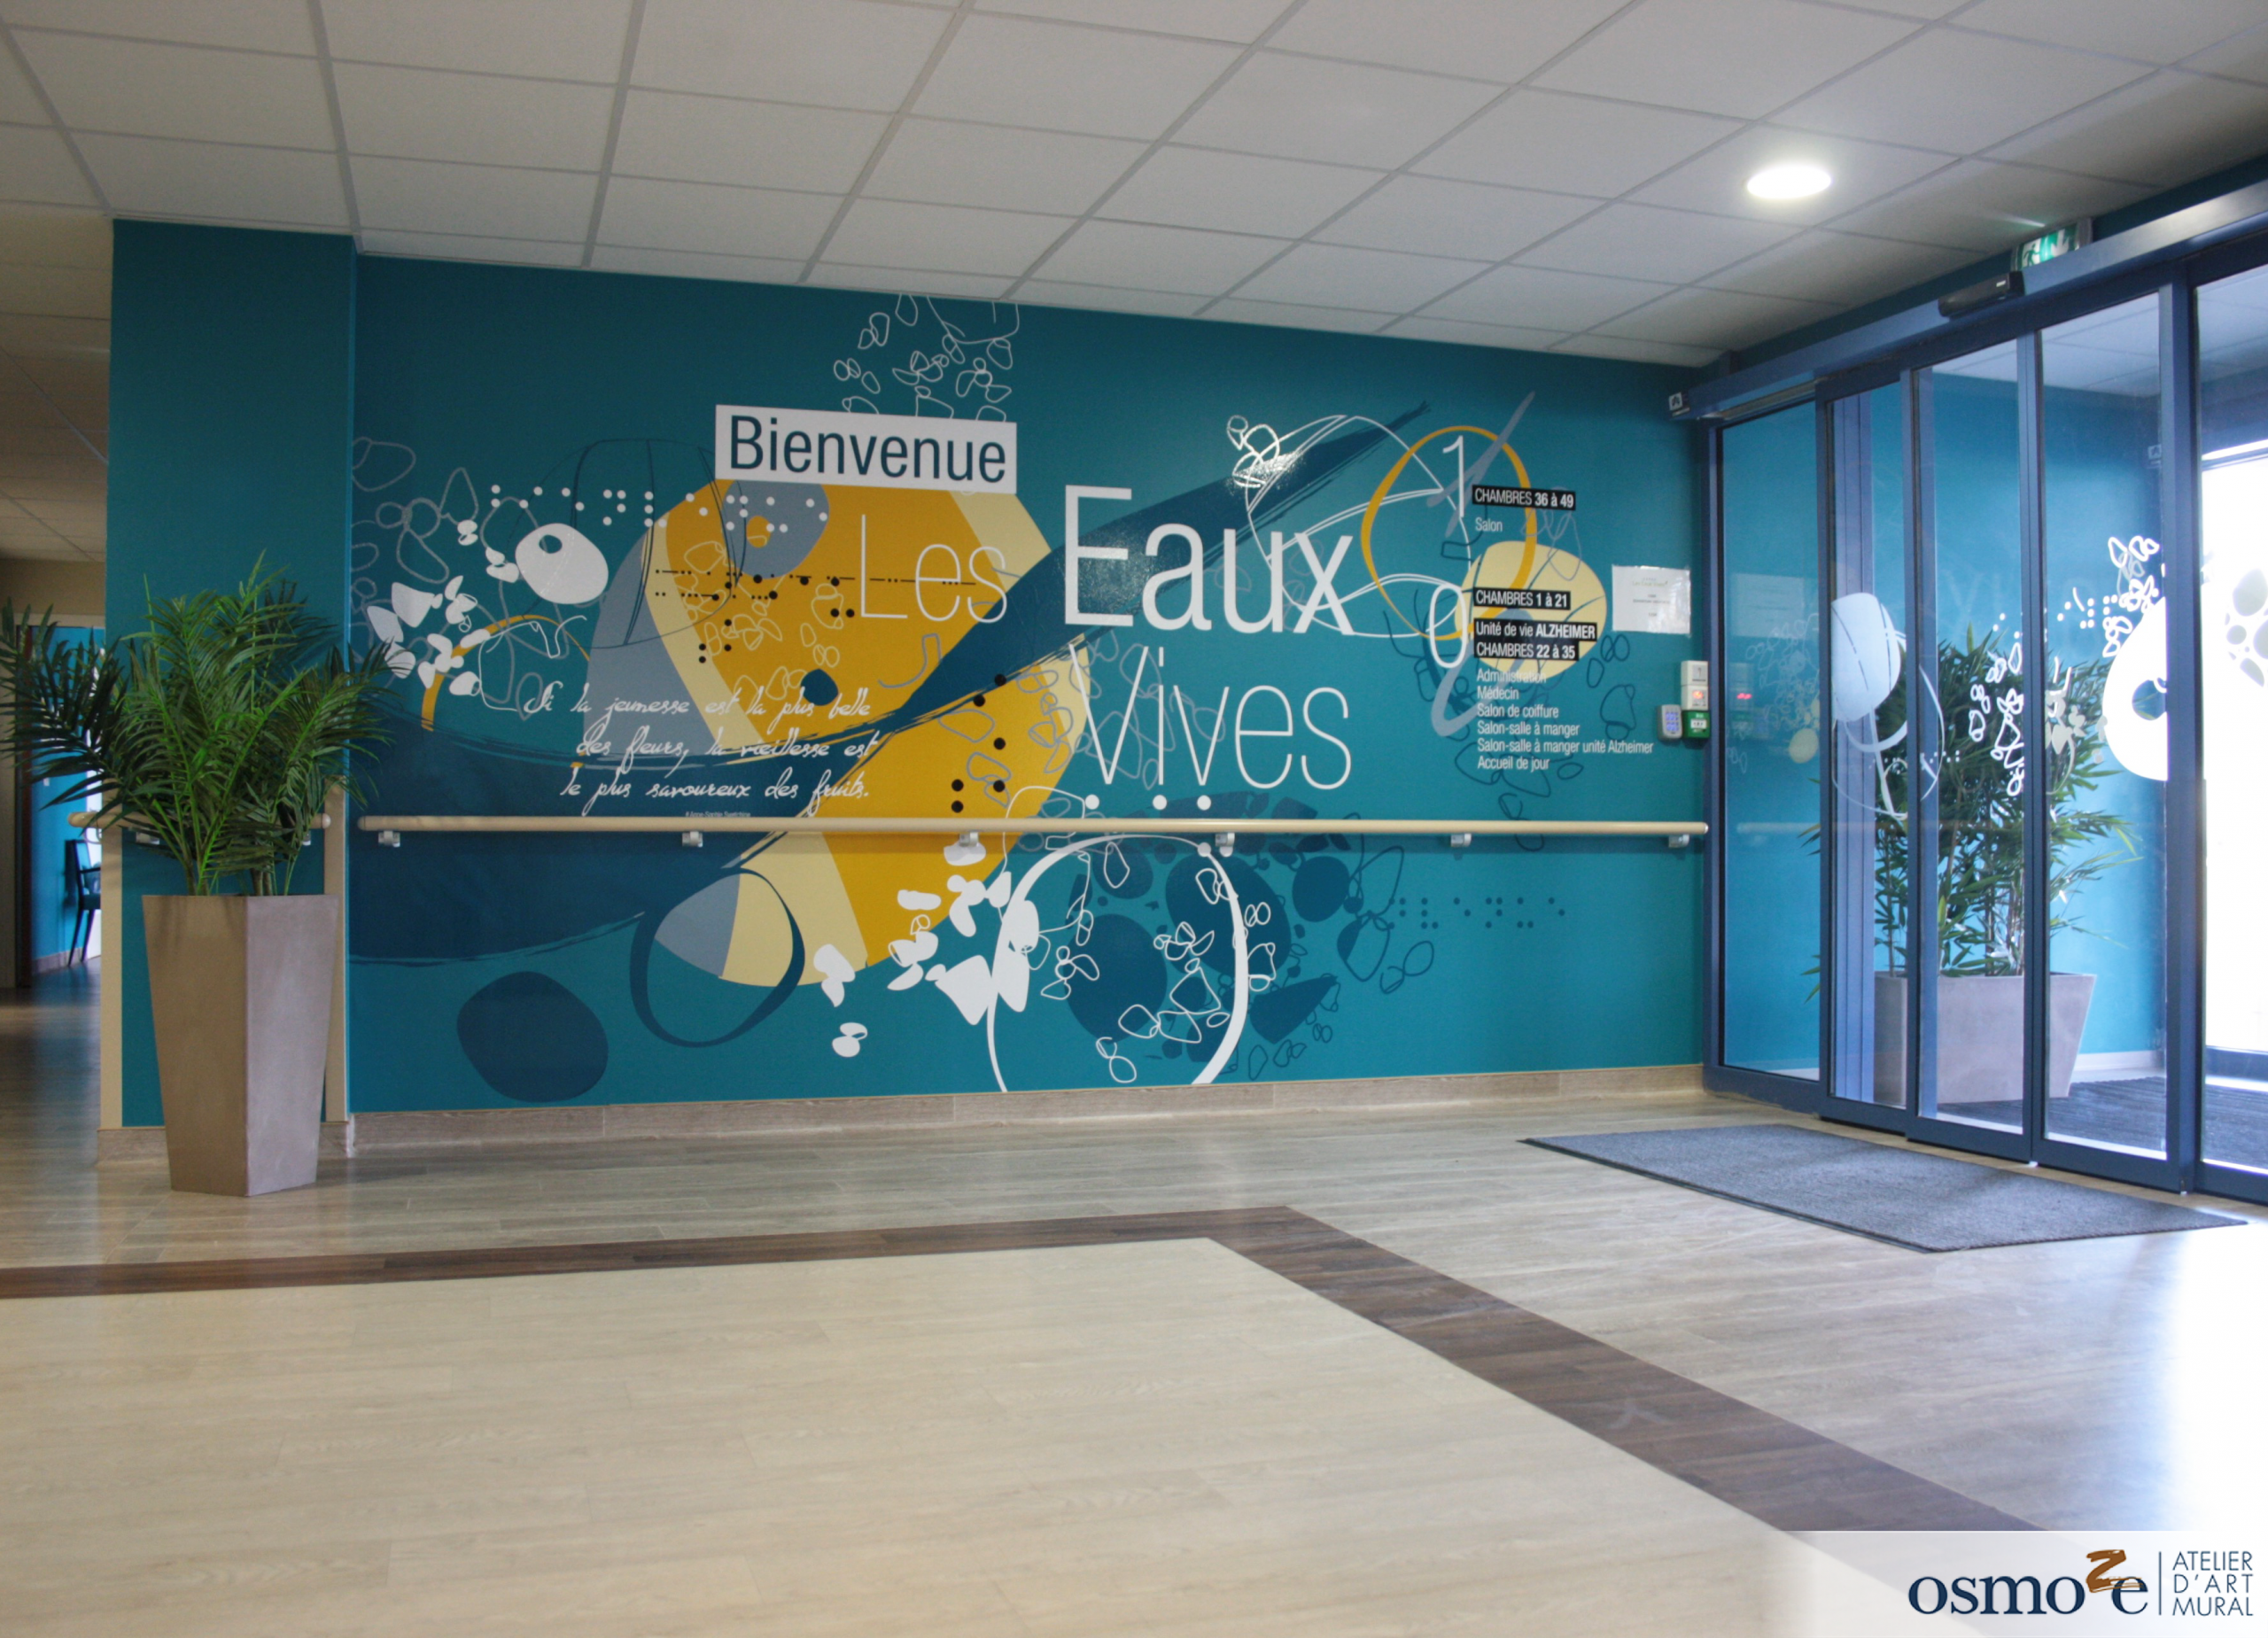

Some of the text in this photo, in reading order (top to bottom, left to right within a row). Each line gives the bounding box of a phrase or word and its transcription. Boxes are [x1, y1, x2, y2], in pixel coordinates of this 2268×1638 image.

[730, 415, 1006, 484] Bienvenue
[1442, 434, 1464, 518] 1
[1474, 487, 1574, 508] CHAMBRES 36 à 49
[1475, 516, 1503, 532] Salon
[860, 484, 1356, 636] Les Eaux
[1475, 589, 1567, 608] CHAMBRES 1 à 21
[1475, 621, 1596, 639] Unité de vie ALZHEIMER
[1476, 641, 1575, 659] CHAMBRES 22 à 35
[1476, 668, 1547, 684] Administration
[1477, 685, 1519, 700] Médecin
[570, 682, 593, 713] la
[583, 697, 690, 743] jeunesse
[704, 687, 742, 715] est
[745, 685, 766, 716] la
[766, 686, 815, 735] plus
[828, 687, 871, 719] belle
[1068, 643, 1353, 790] Vives
[1477, 703, 1559, 718] Salon de coiffure
[1477, 721, 1581, 739] Salon-salle à manger
[576, 722, 612, 757] des
[704, 726, 726, 757] la
[740, 727, 830, 758] vieillesse
[843, 730, 881, 758] est
[1477, 737, 1654, 756] Salon-salle à manger unité Alzheimer
[1477, 755, 1551, 773] Accueil de jour
[559, 765, 870, 818] le plus savoureux des fruits.
